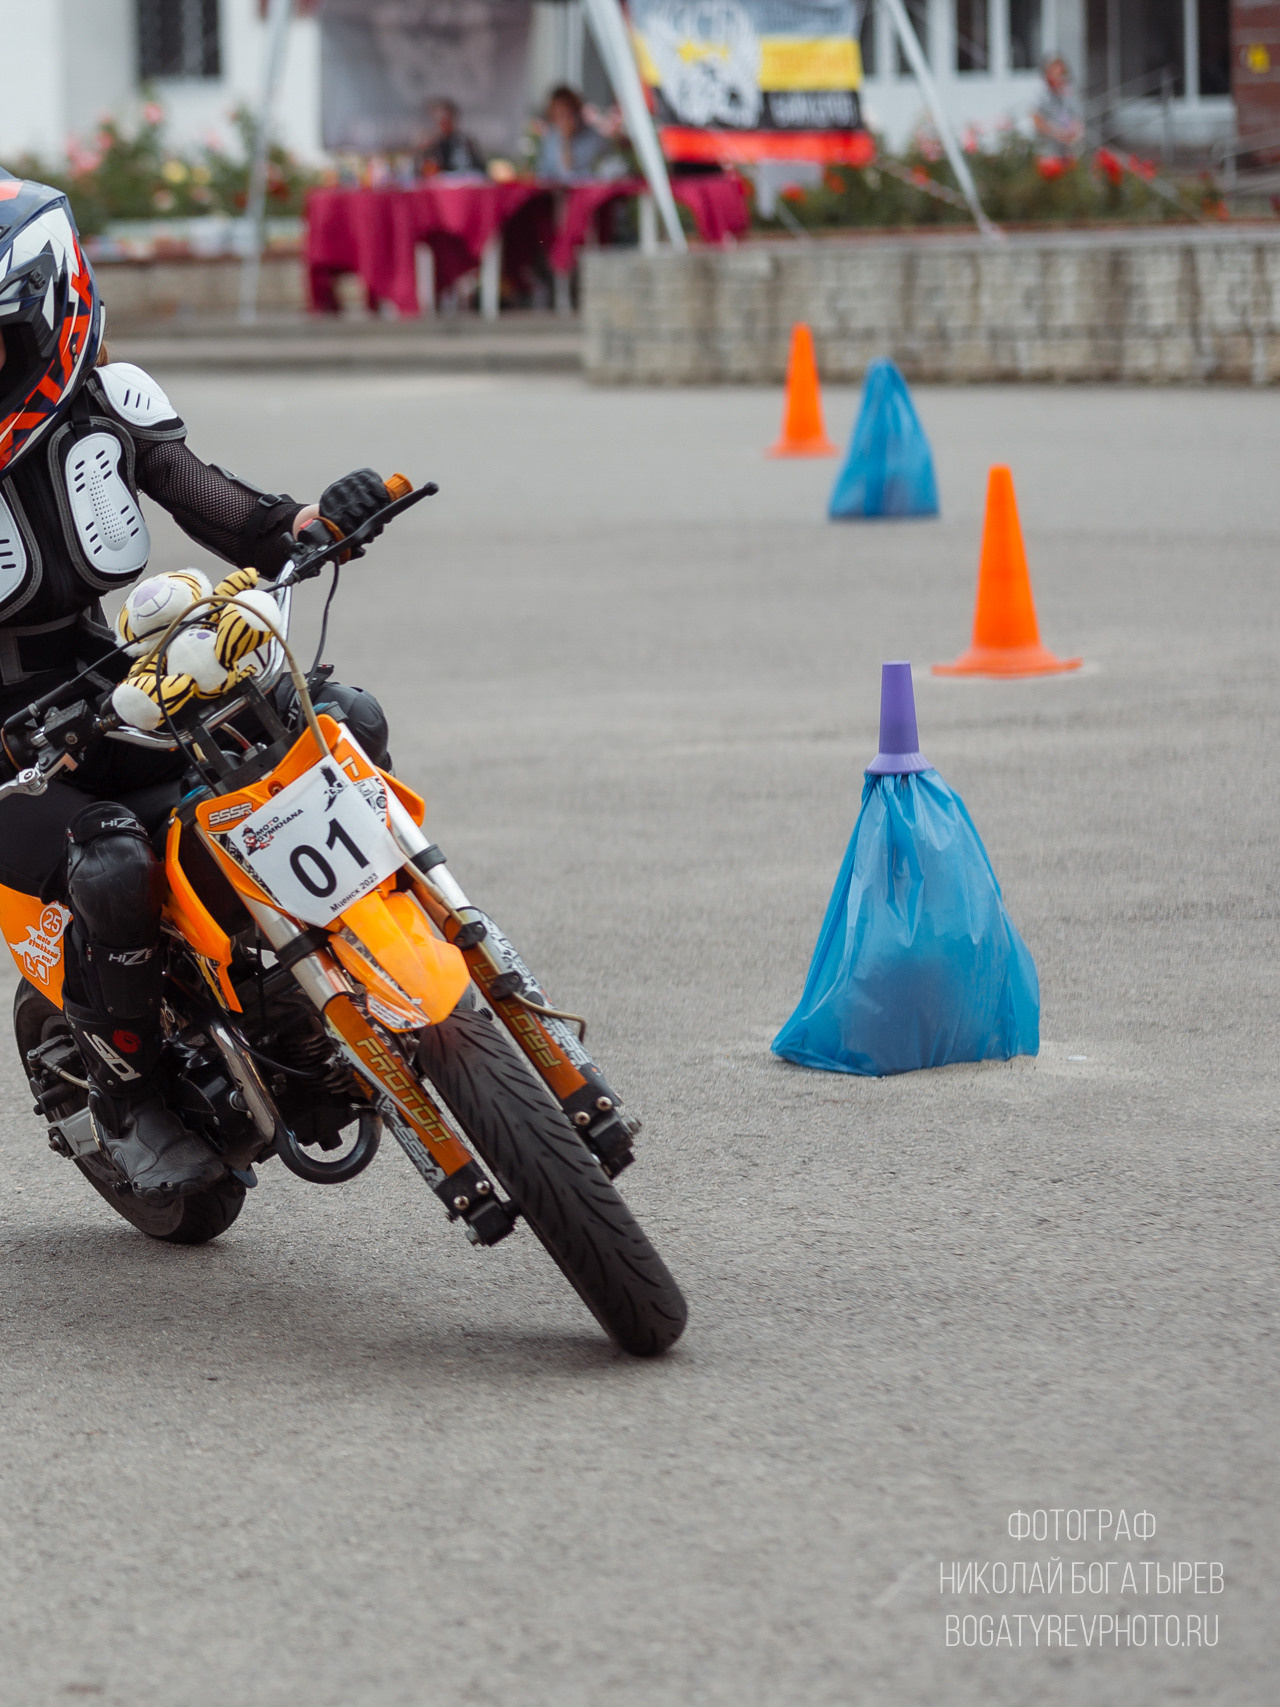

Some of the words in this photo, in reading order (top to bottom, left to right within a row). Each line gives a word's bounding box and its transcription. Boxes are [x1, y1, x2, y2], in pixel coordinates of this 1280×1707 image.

[208, 802, 254, 828] SSSR
[289, 817, 370, 898] 01
[329, 887, 361, 912] Мценск
[359, 872, 379, 890] 2023
[43, 910, 62, 933] 25
